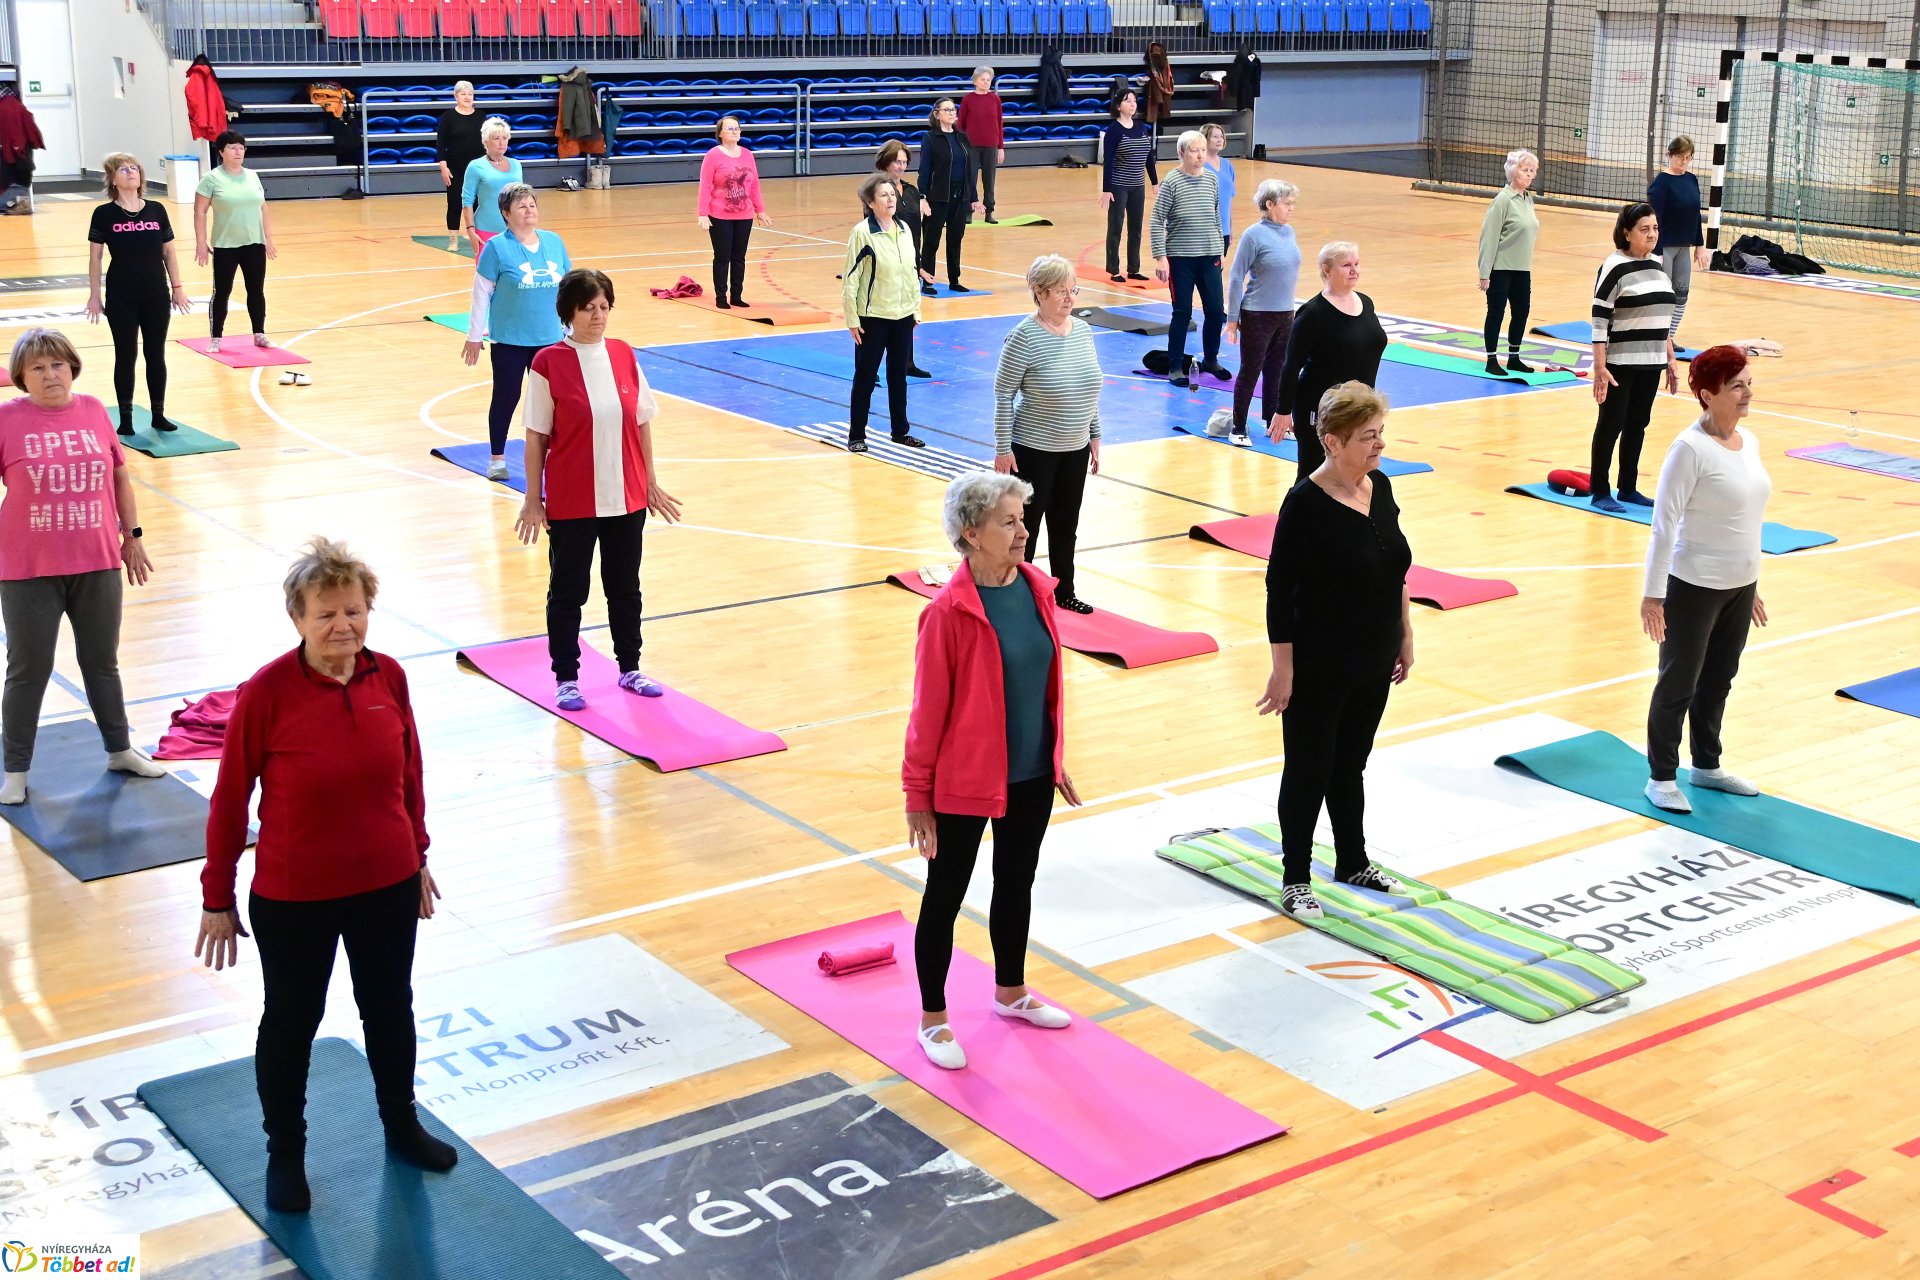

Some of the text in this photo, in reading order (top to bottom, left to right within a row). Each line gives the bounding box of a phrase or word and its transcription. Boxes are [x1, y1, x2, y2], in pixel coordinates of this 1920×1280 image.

[112, 220, 160, 232] adidas
[24, 429, 103, 458] OPEN
[26, 460, 107, 494] YOUR
[30, 500, 103, 531] MIND
[1499, 845, 1763, 928] ÍREGYHÁZI
[1565, 869, 1820, 953] ORTCENTR
[1619, 886, 1860, 971] yházi Sportcentrum Nonpr
[414, 1008, 646, 1087] TRUM
[461, 1049, 610, 1097] Nonprofit
[614, 1034, 671, 1061] Kft.
[574, 1158, 890, 1265] Aréna
